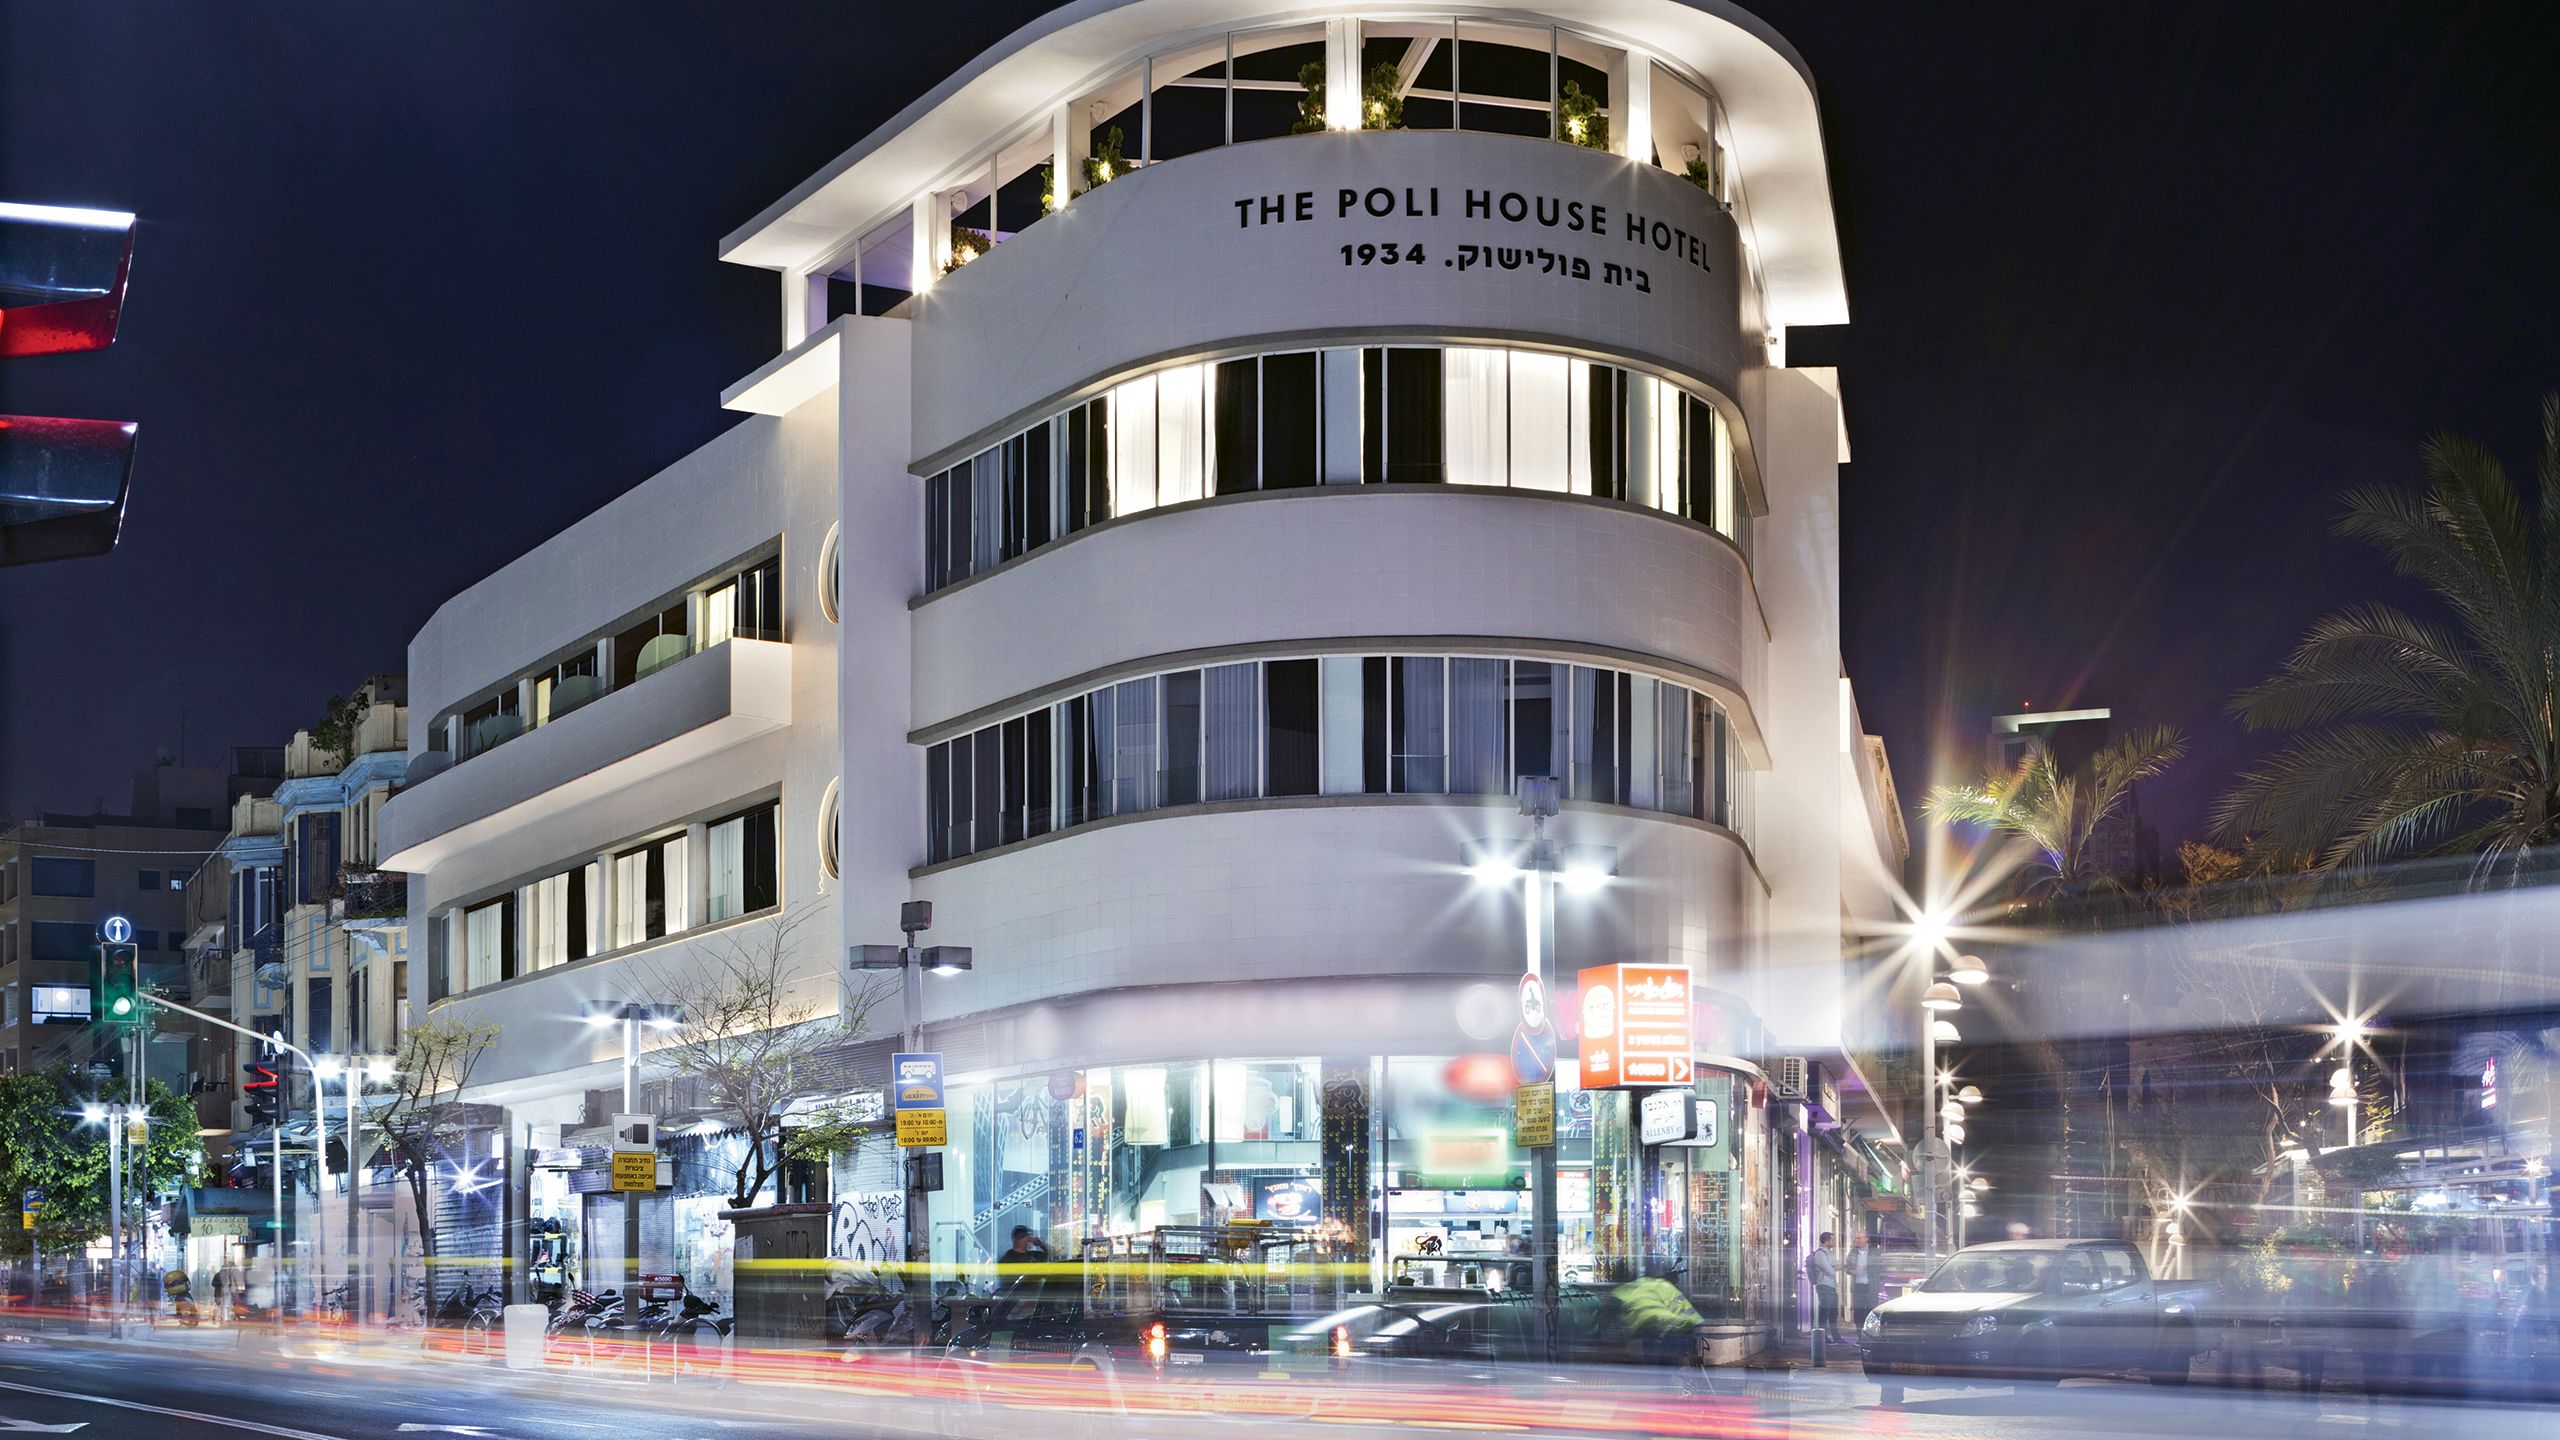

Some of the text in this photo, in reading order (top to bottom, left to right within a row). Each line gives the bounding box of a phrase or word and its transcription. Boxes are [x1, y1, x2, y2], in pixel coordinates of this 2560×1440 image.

[1235, 187, 1711, 273] THE POLI HOUSE HOTEL
[1340, 243, 1426, 266] 1934
[1603, 262, 1652, 295] בית
[1074, 1131, 1083, 1144] 62
[1645, 1125, 1675, 1138] ALLENBY
